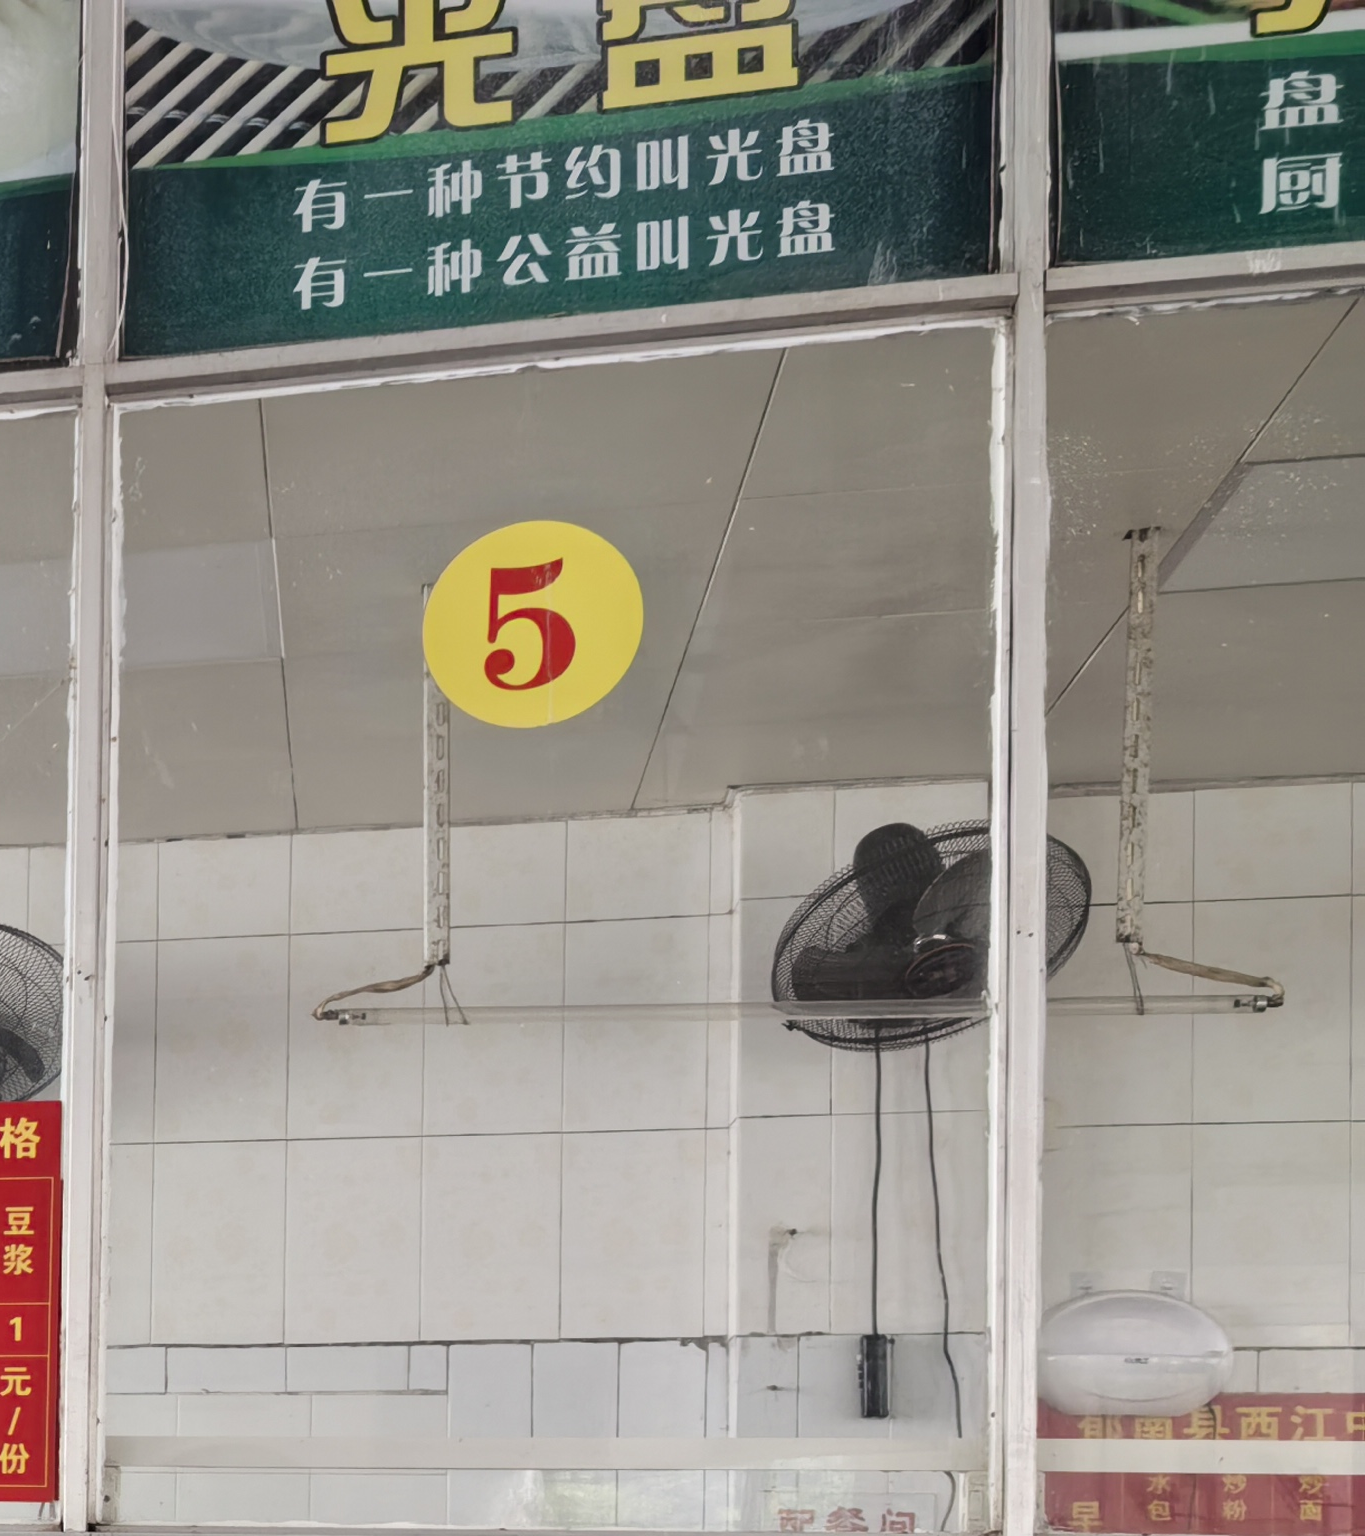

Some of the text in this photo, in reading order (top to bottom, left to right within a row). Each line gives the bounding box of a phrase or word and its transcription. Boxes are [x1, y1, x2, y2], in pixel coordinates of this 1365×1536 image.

[1259, 71, 1344, 130] 盘
[293, 119, 835, 233] 有一种节约叫光盘
[293, 200, 835, 311] 有一种公益叫光盘
[485, 560, 575, 690] 5
[3, 1206, 35, 1276] 豆浆
[9, 1316, 23, 1342] 1
